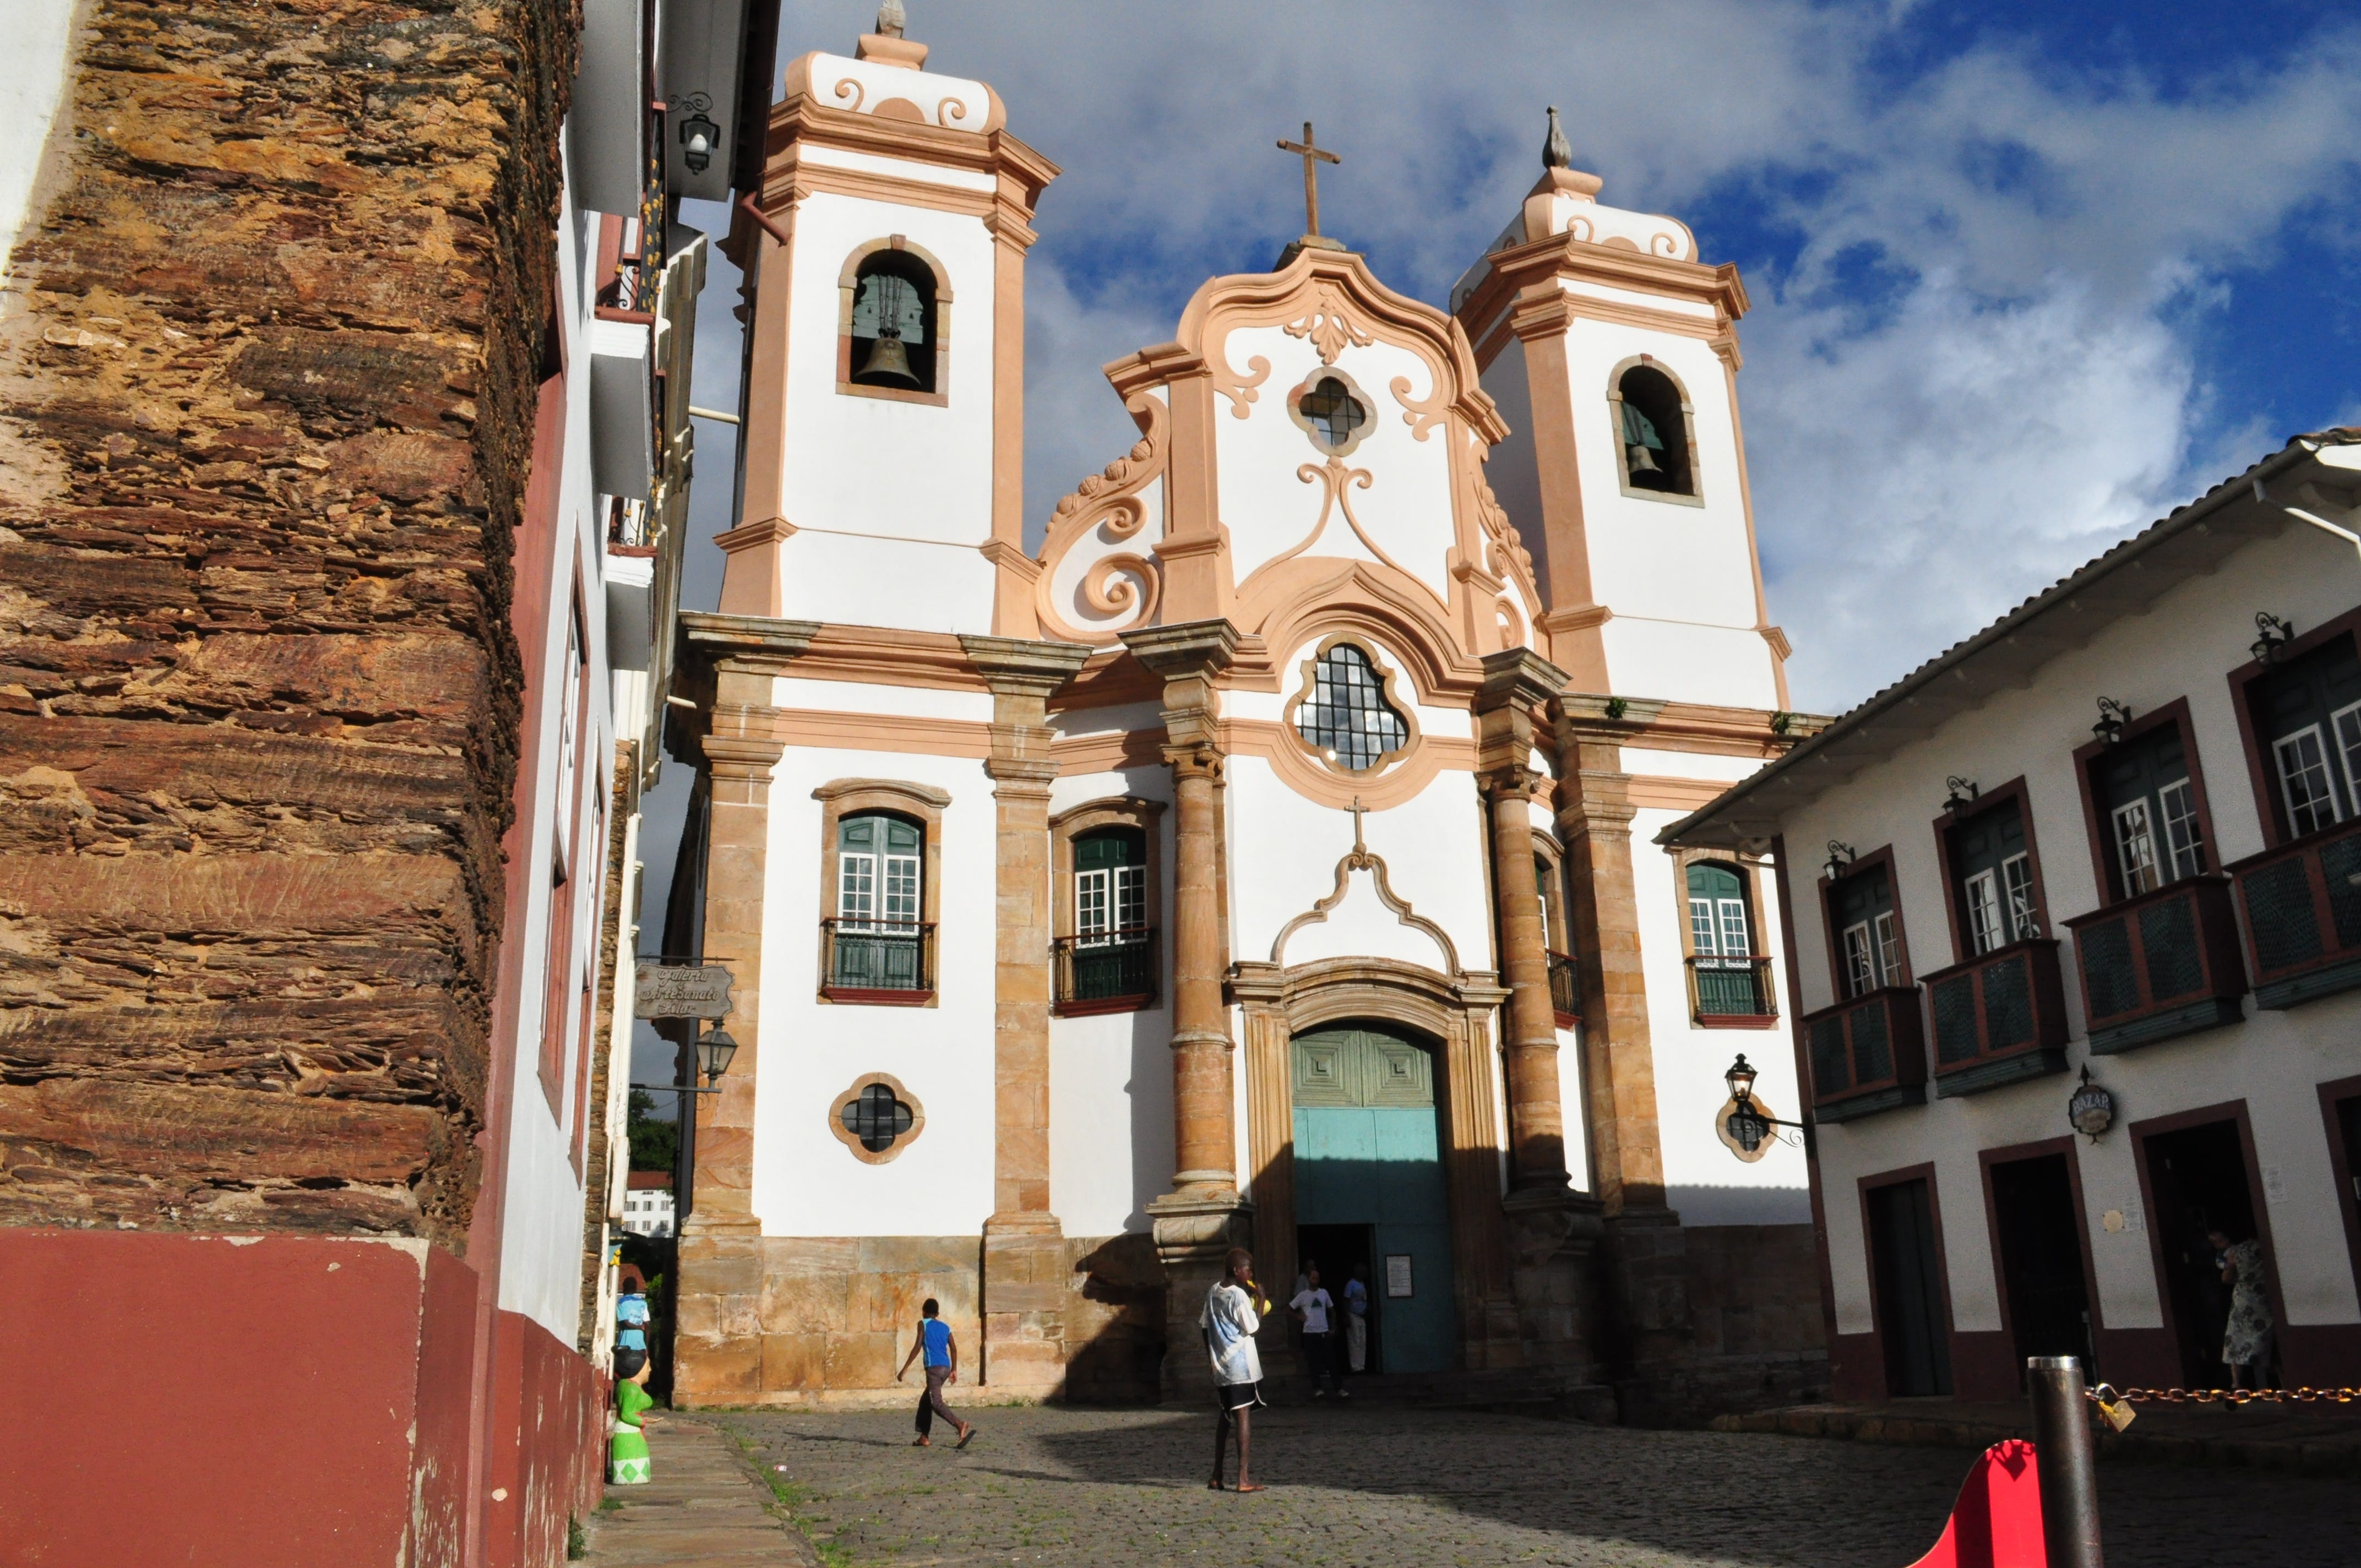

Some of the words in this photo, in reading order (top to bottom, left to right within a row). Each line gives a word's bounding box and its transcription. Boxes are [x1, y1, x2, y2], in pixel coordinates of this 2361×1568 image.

[640, 986, 720, 1001] Artesanato
[658, 1000, 696, 1014] Pilar
[2073, 1094, 2109, 1113] BAZAR
